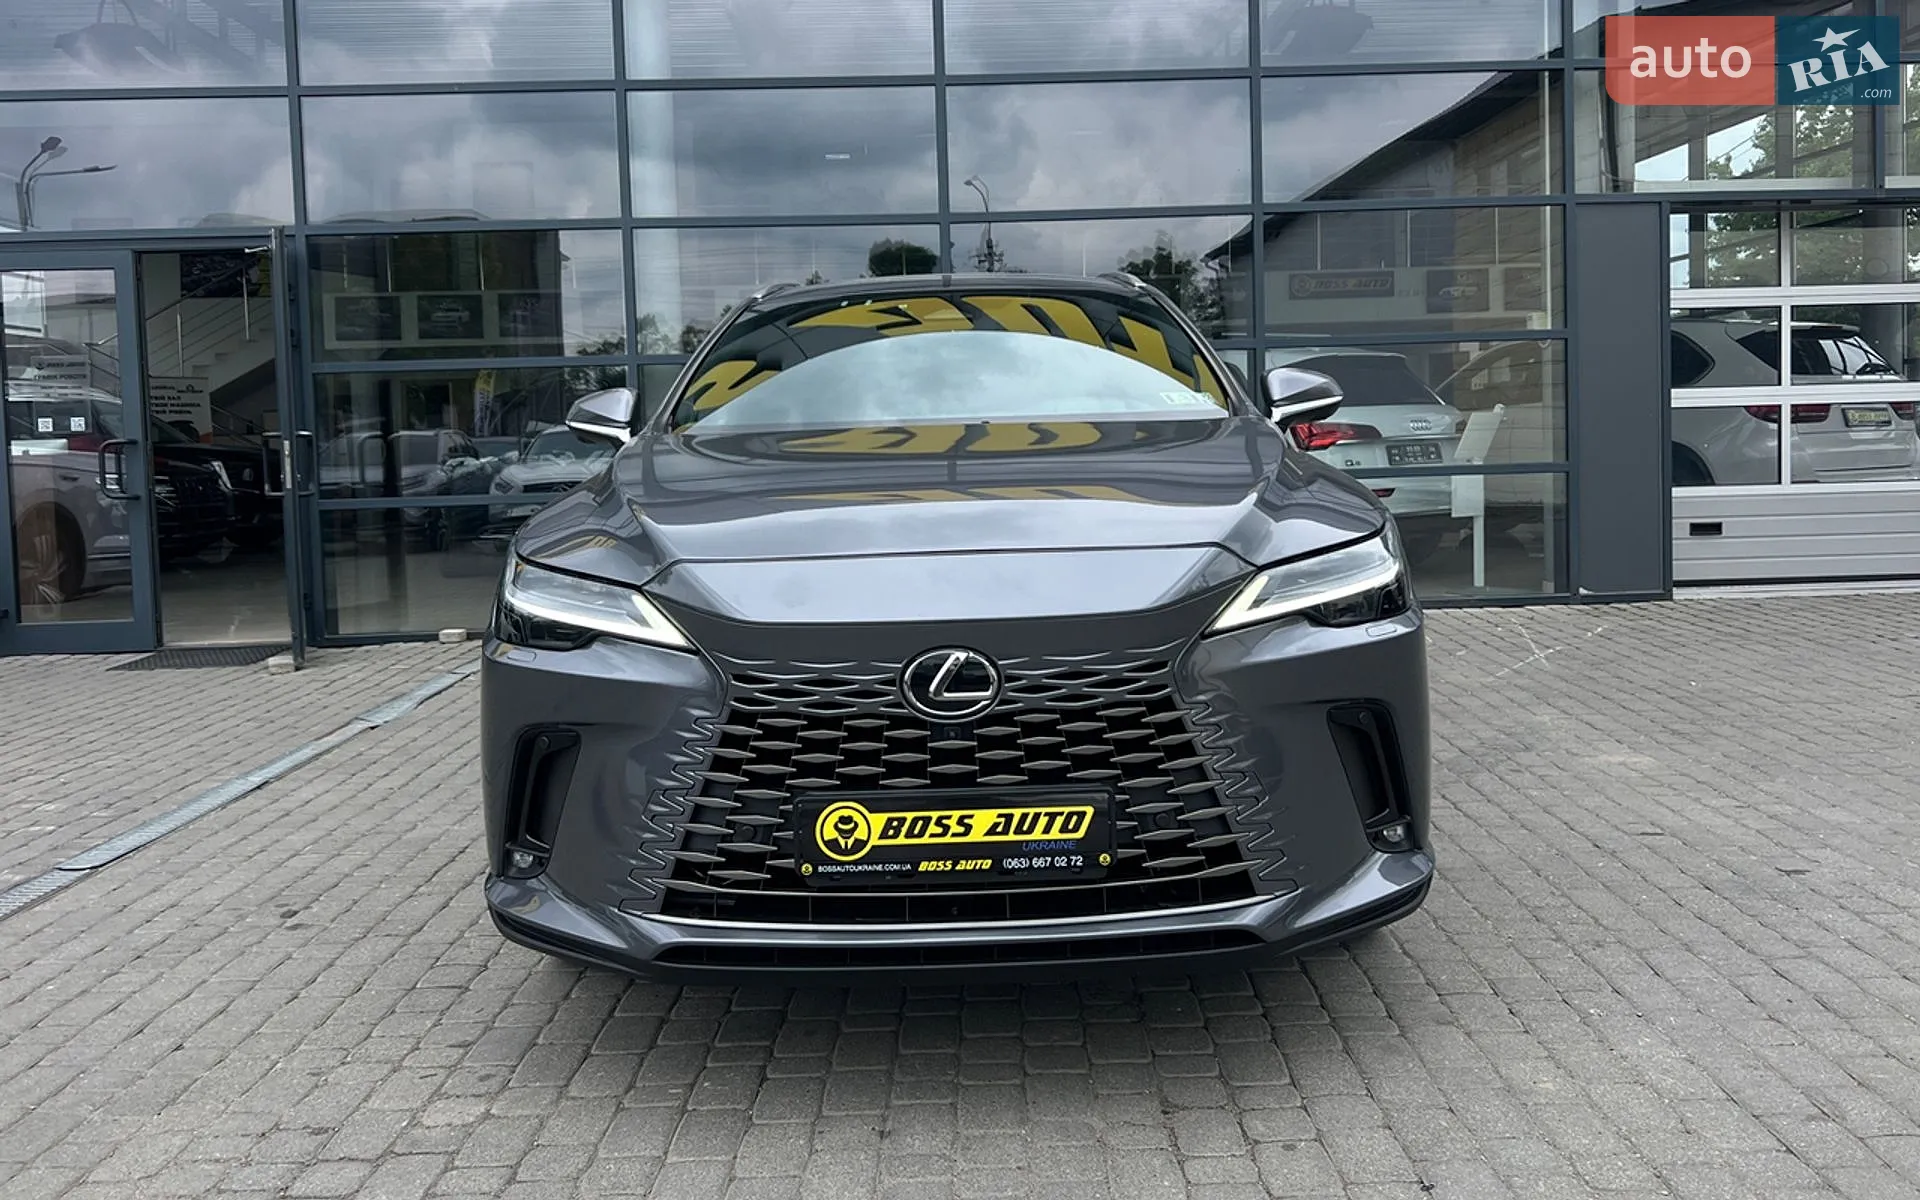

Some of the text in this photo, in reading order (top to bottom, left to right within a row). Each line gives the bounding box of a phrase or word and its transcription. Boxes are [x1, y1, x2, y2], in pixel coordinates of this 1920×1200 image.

[877, 810, 1088, 840] BOSS AUTO
[1022, 840, 1077, 851] UKRAINE
[817, 863, 912, 873] BOSSAUTOUKRAINE.COM.UA
[917, 859, 993, 872] BOSS AUTO
[1003, 855, 1084, 869] (063) 667 02 72
